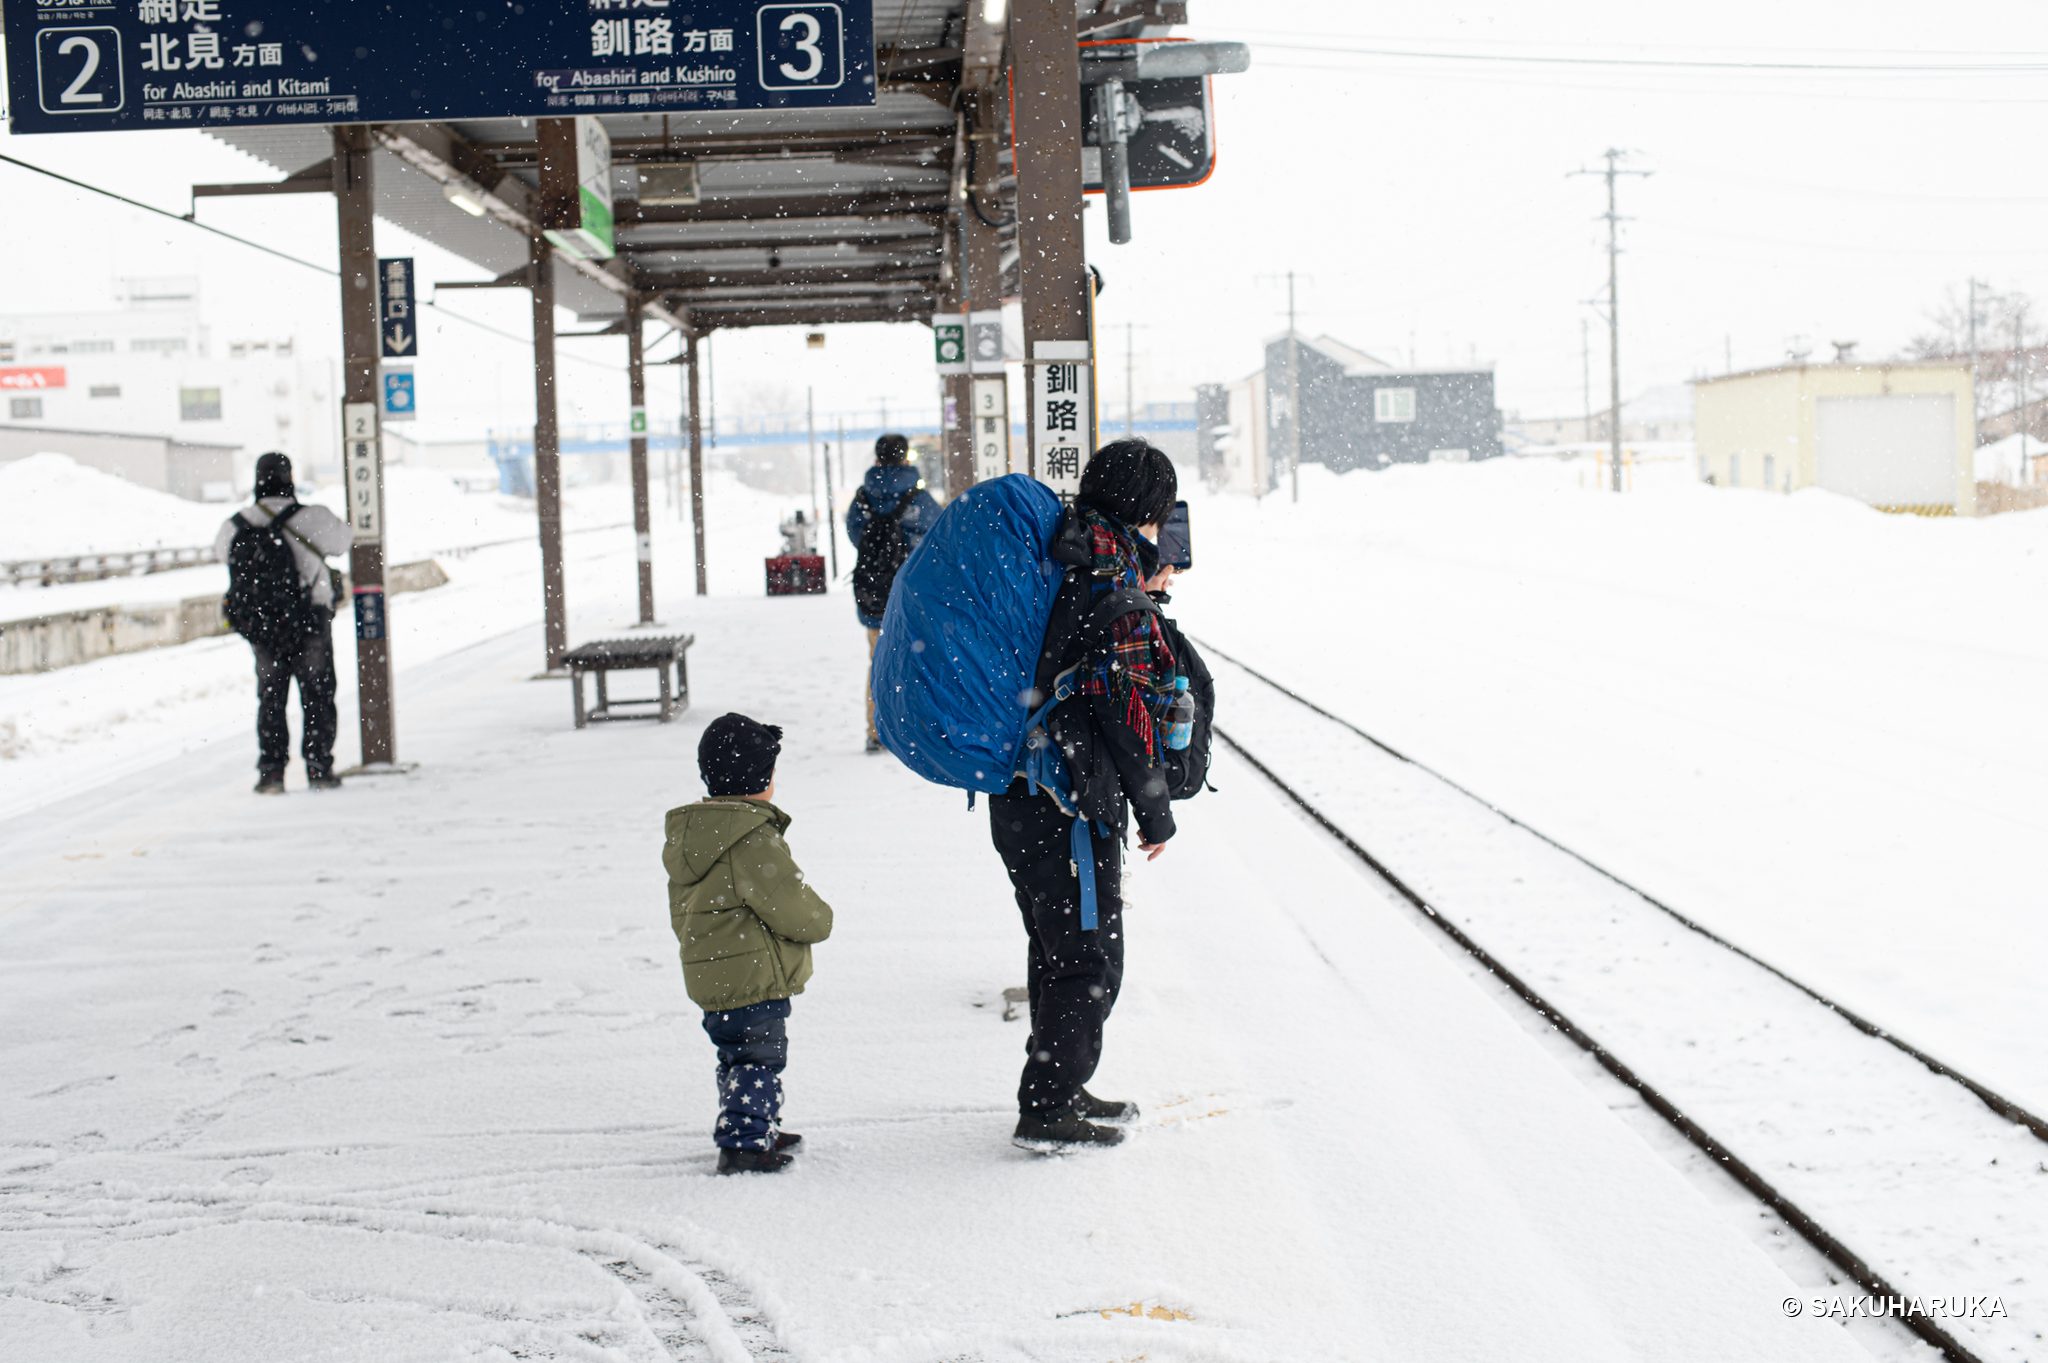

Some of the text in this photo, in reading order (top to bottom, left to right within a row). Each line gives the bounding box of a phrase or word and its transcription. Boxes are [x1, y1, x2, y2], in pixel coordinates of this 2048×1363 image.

[138, 0, 223, 24] 網走
[778, 13, 824, 81] 3
[58, 36, 104, 104] 2
[536, 65, 737, 88] for Abashiri and Kushiro
[143, 76, 330, 100] for Abashiri and Kitami
